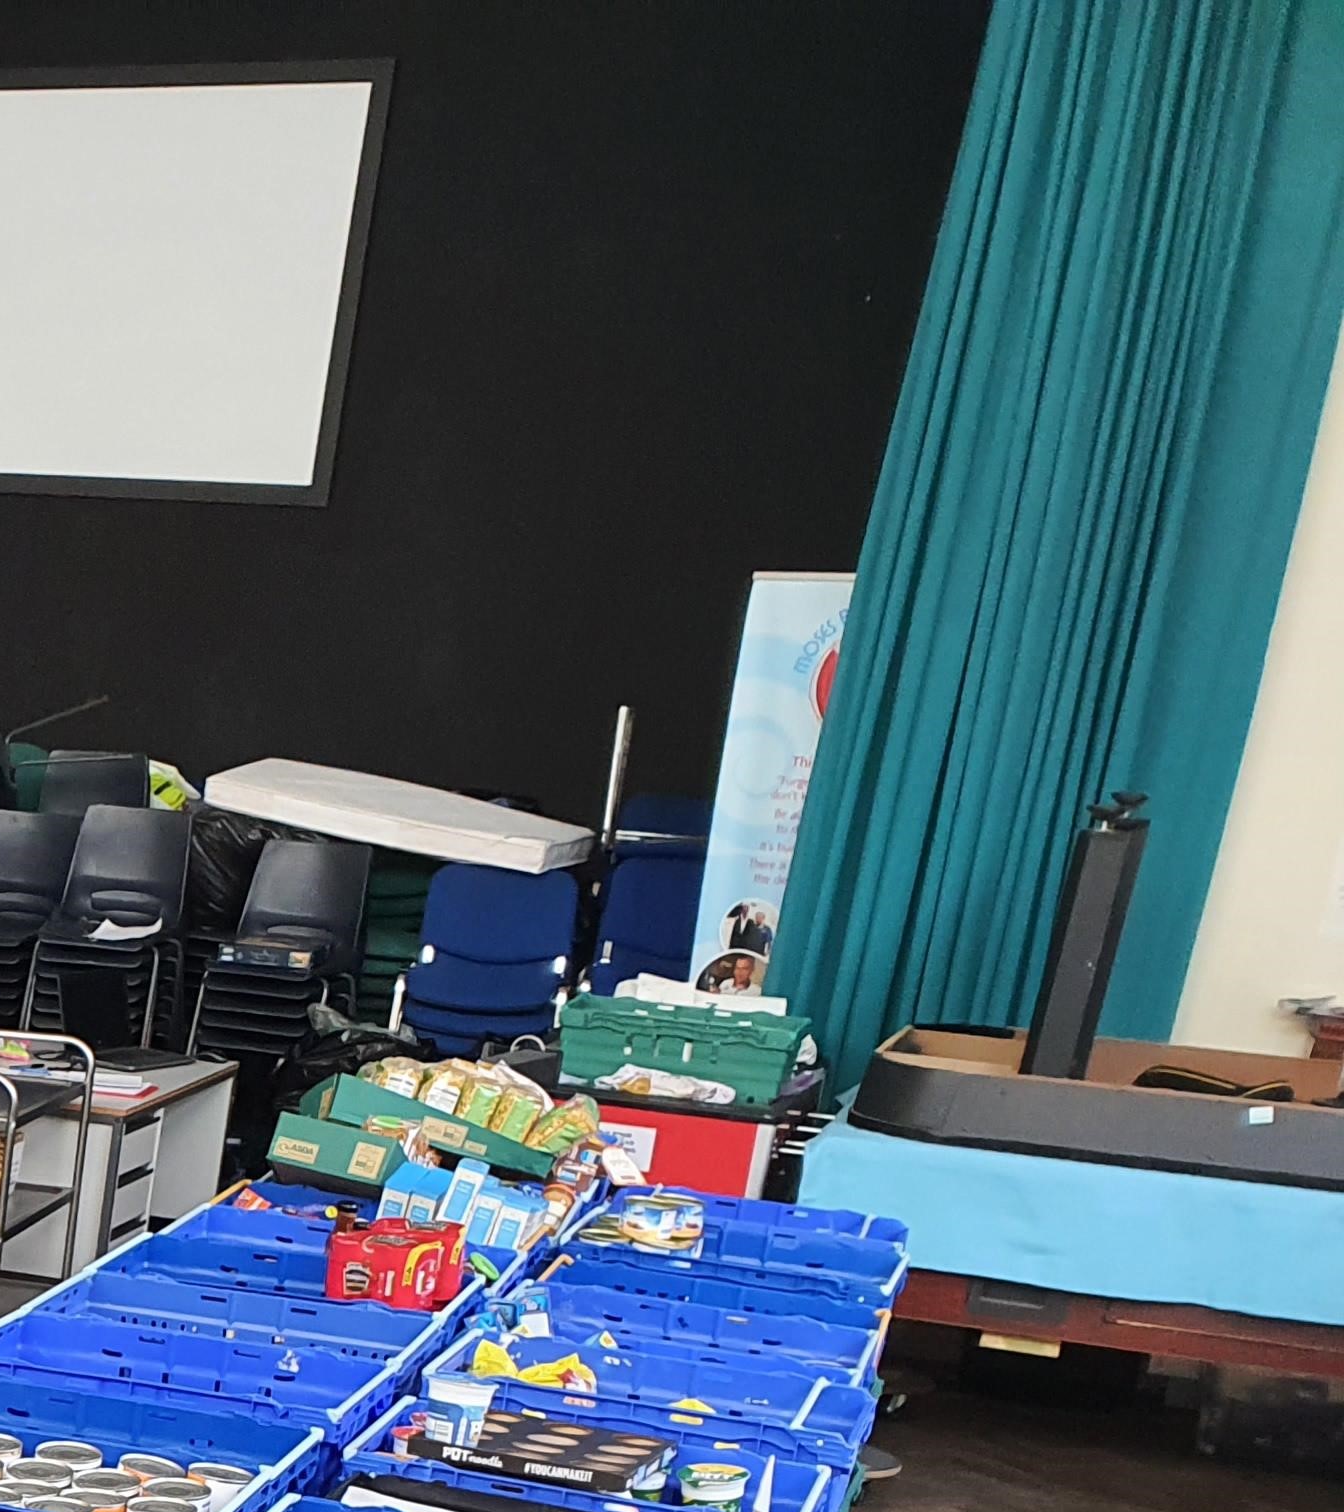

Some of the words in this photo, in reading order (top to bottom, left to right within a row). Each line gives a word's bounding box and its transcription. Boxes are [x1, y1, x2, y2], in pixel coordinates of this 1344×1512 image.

[794, 618, 837, 674] MOSES
[293, 1143, 314, 1154] ASDA
[442, 1446, 467, 1462] POT
[523, 1462, 593, 1483] #YOUCANMAKEIT
